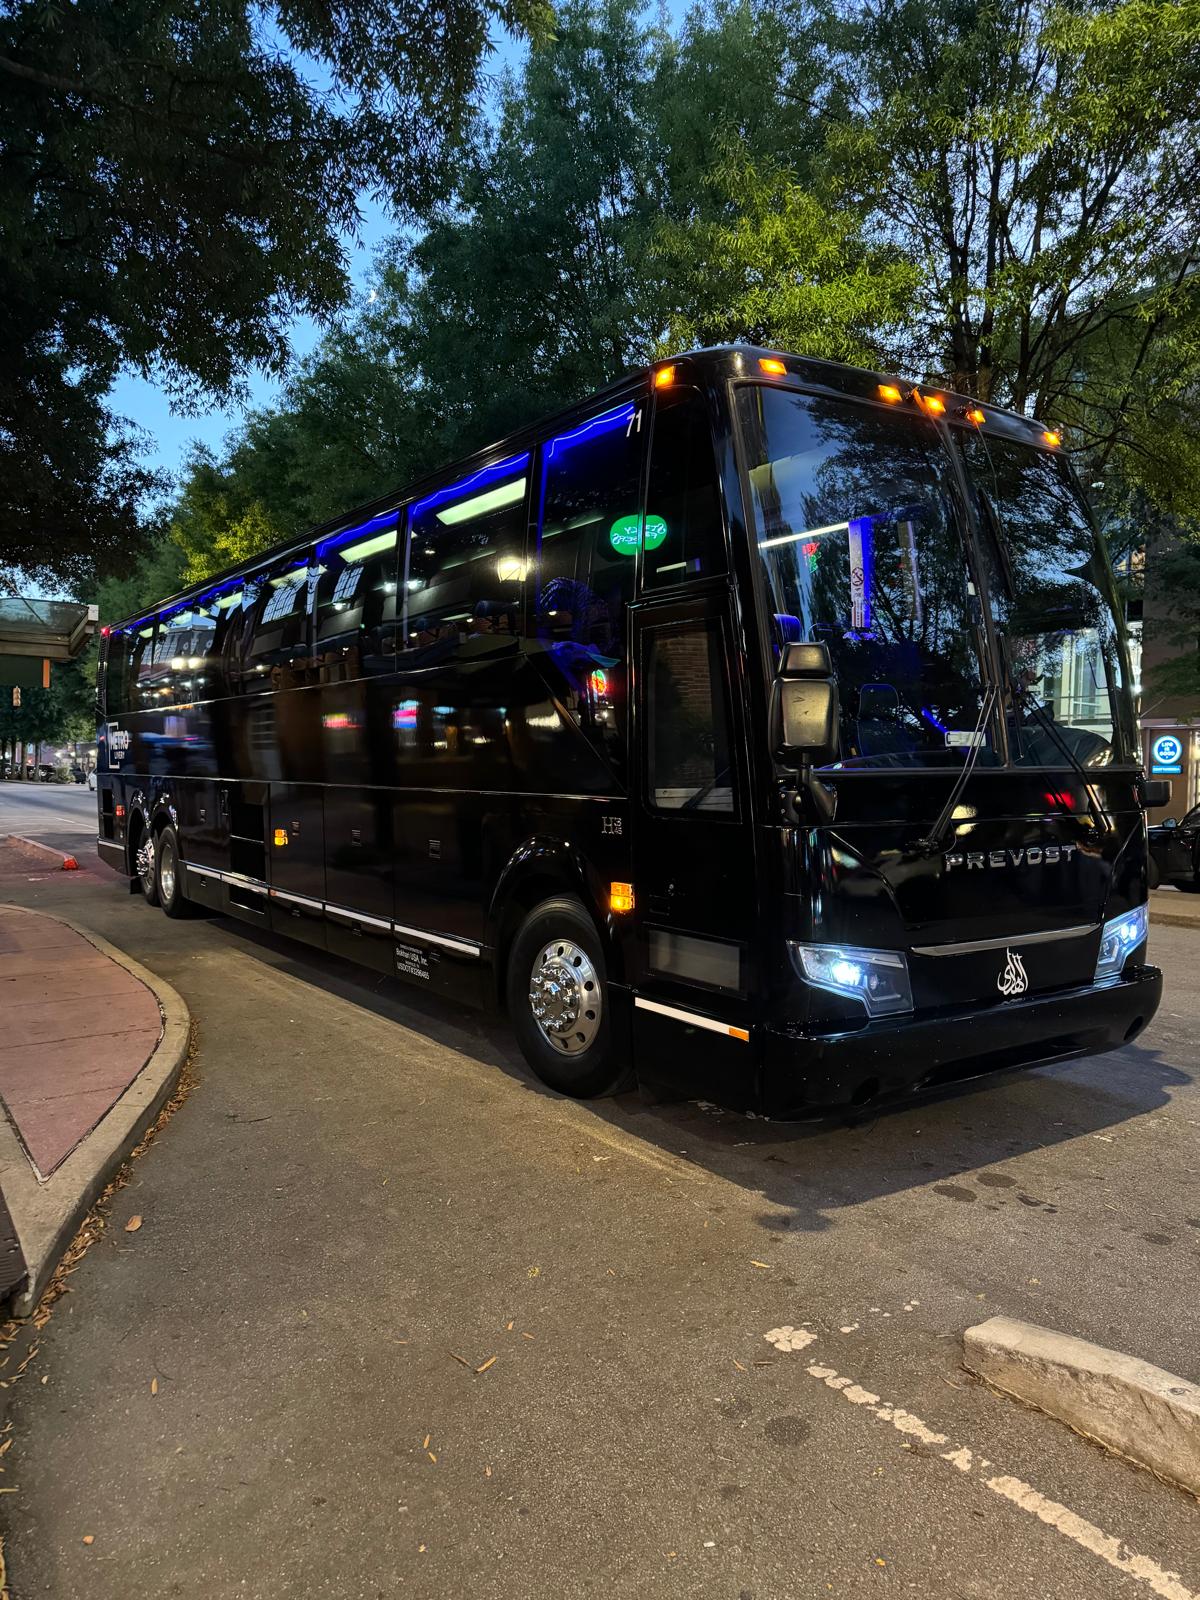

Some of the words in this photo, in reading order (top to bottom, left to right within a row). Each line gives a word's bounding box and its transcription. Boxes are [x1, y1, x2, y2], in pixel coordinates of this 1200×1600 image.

[626, 409, 642, 437] 71
[110, 730, 129, 750] METRO
[945, 845, 1076, 872] PREVOST
